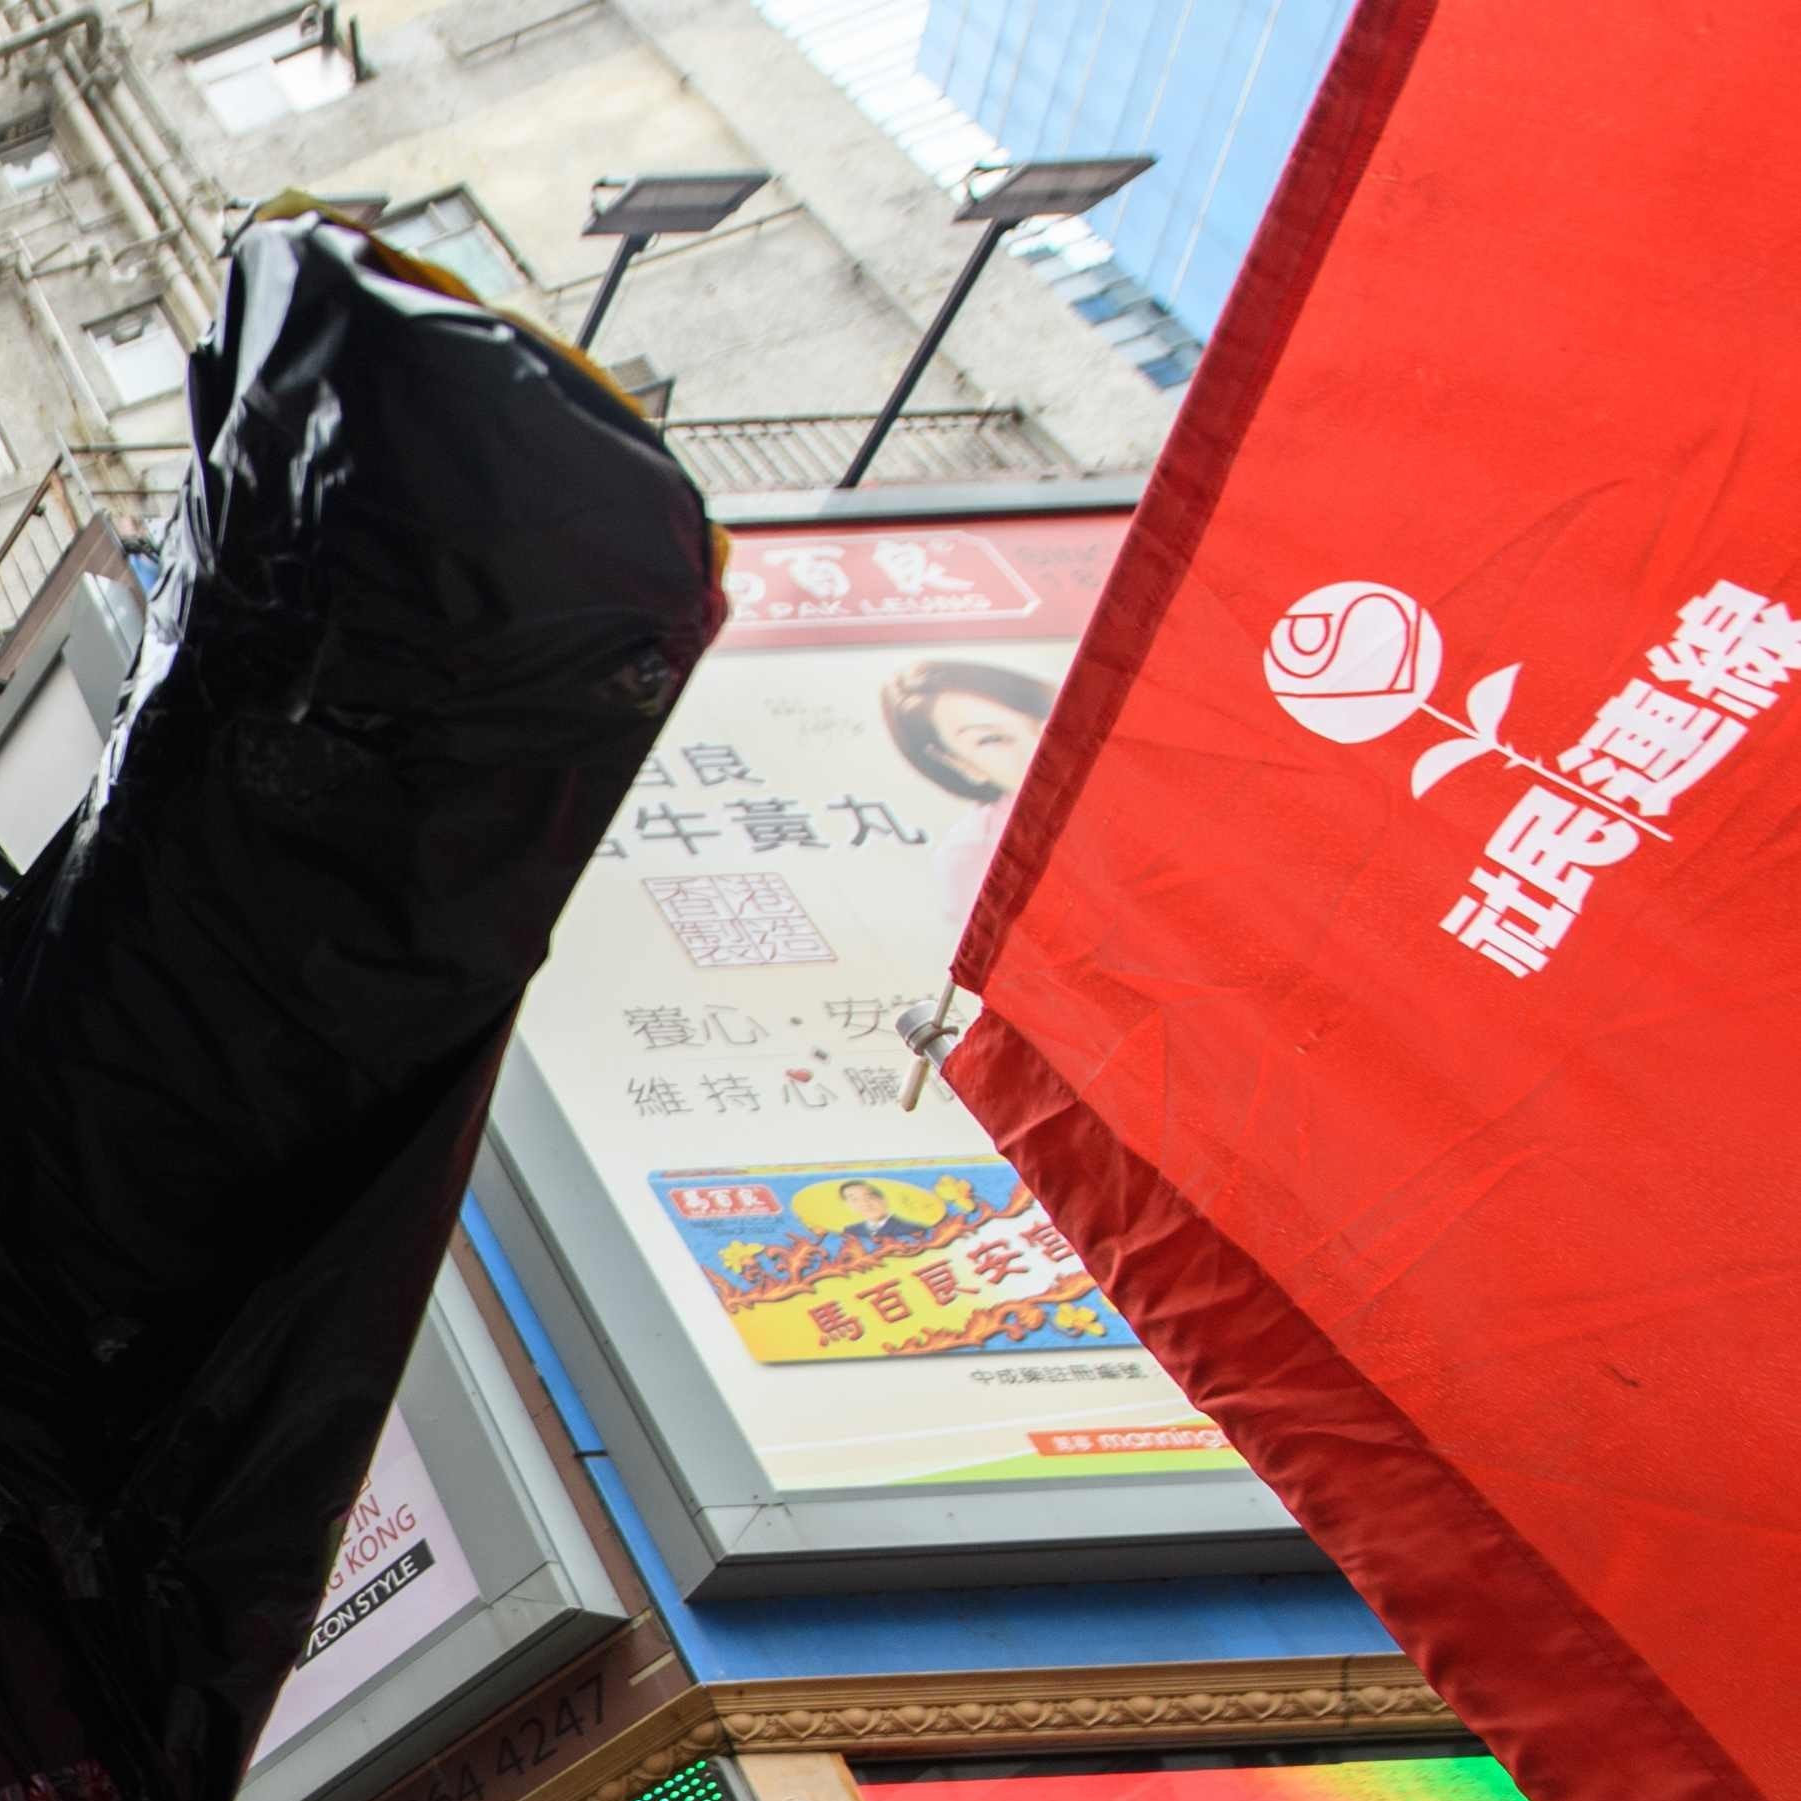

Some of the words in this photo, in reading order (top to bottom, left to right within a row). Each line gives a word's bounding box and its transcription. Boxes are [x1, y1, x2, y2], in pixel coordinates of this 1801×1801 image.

[595, 795, 928, 859] 牛黃丸
[345, 1503, 417, 1574] KONG
[355, 1555, 418, 1616] STYLE
[496, 1673, 607, 1779] 4247
